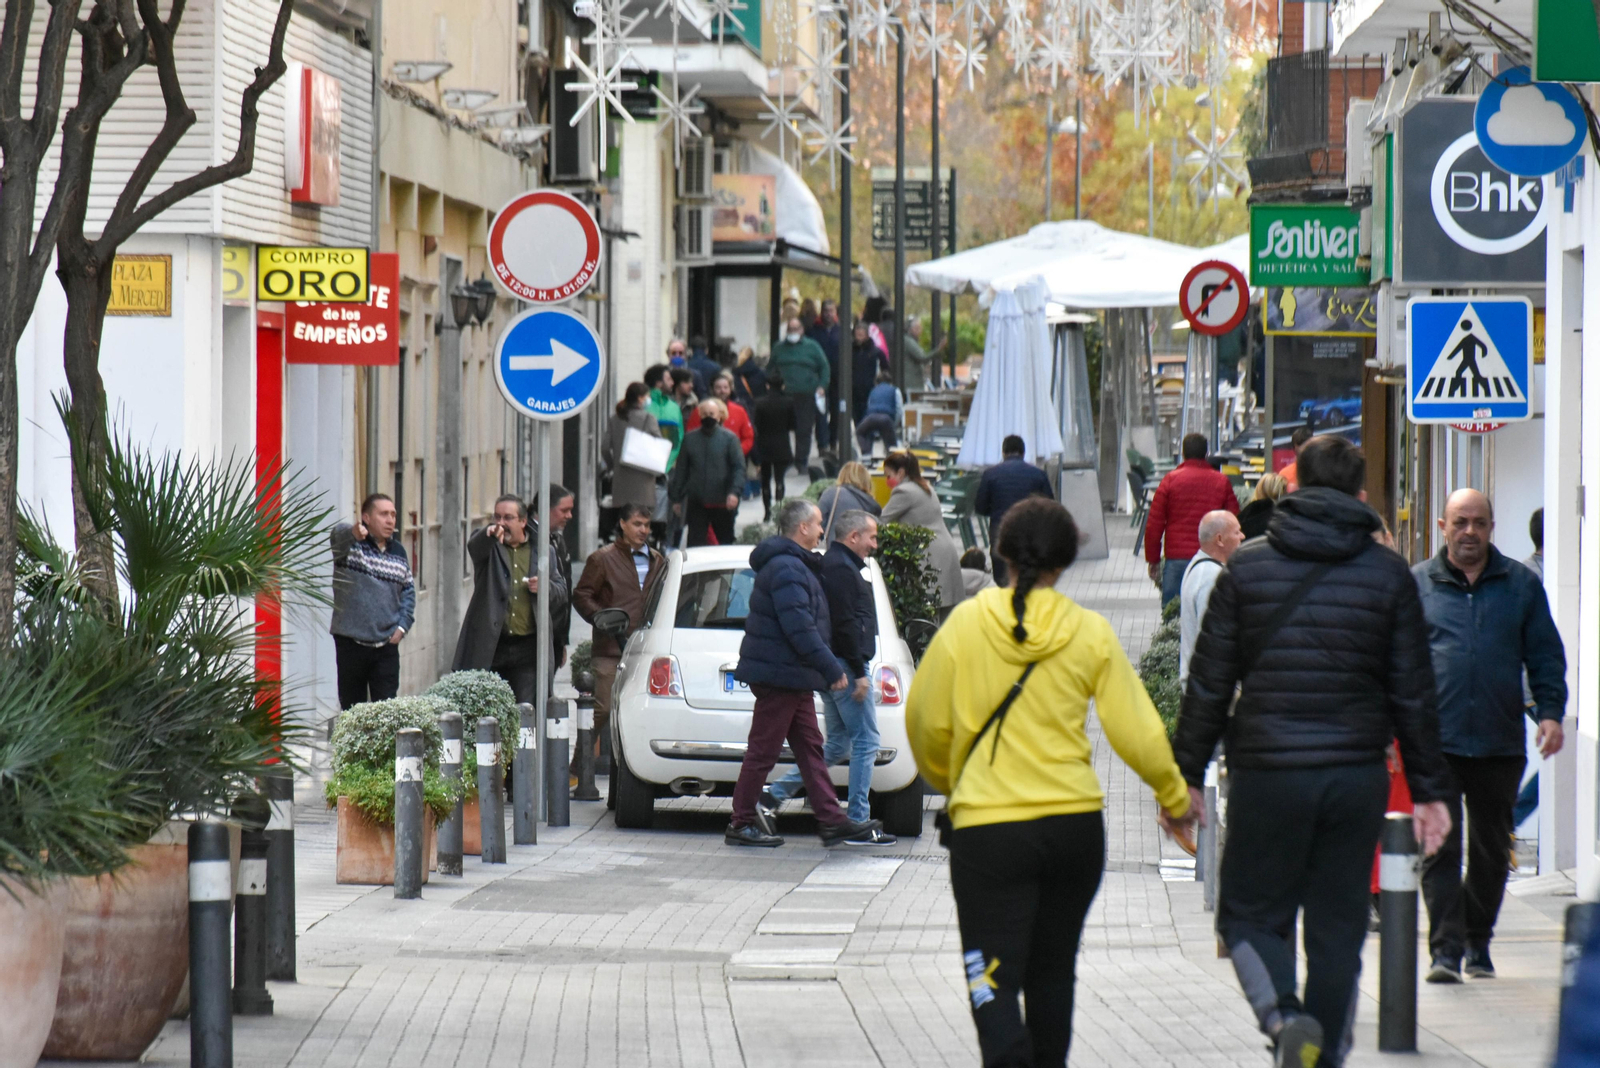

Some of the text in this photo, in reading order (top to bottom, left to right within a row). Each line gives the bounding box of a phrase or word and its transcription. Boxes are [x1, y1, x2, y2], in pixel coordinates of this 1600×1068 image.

[1450, 171, 1537, 212] Bhk
[270, 251, 354, 264] COMPRO
[1259, 261, 1318, 273] DIETÉTICA
[1322, 262, 1330, 273] Y
[113, 263, 153, 282] PLAZA
[496, 262, 510, 280] DE
[509, 278, 536, 298] 12:00
[539, 290, 550, 300] H.
[553, 288, 562, 299] A
[563, 272, 588, 295] 01:00
[263, 269, 361, 298] ORO
[322, 307, 361, 321] de los
[293, 321, 388, 345] EMPEÑOS
[527, 397, 576, 411] GARAJES
